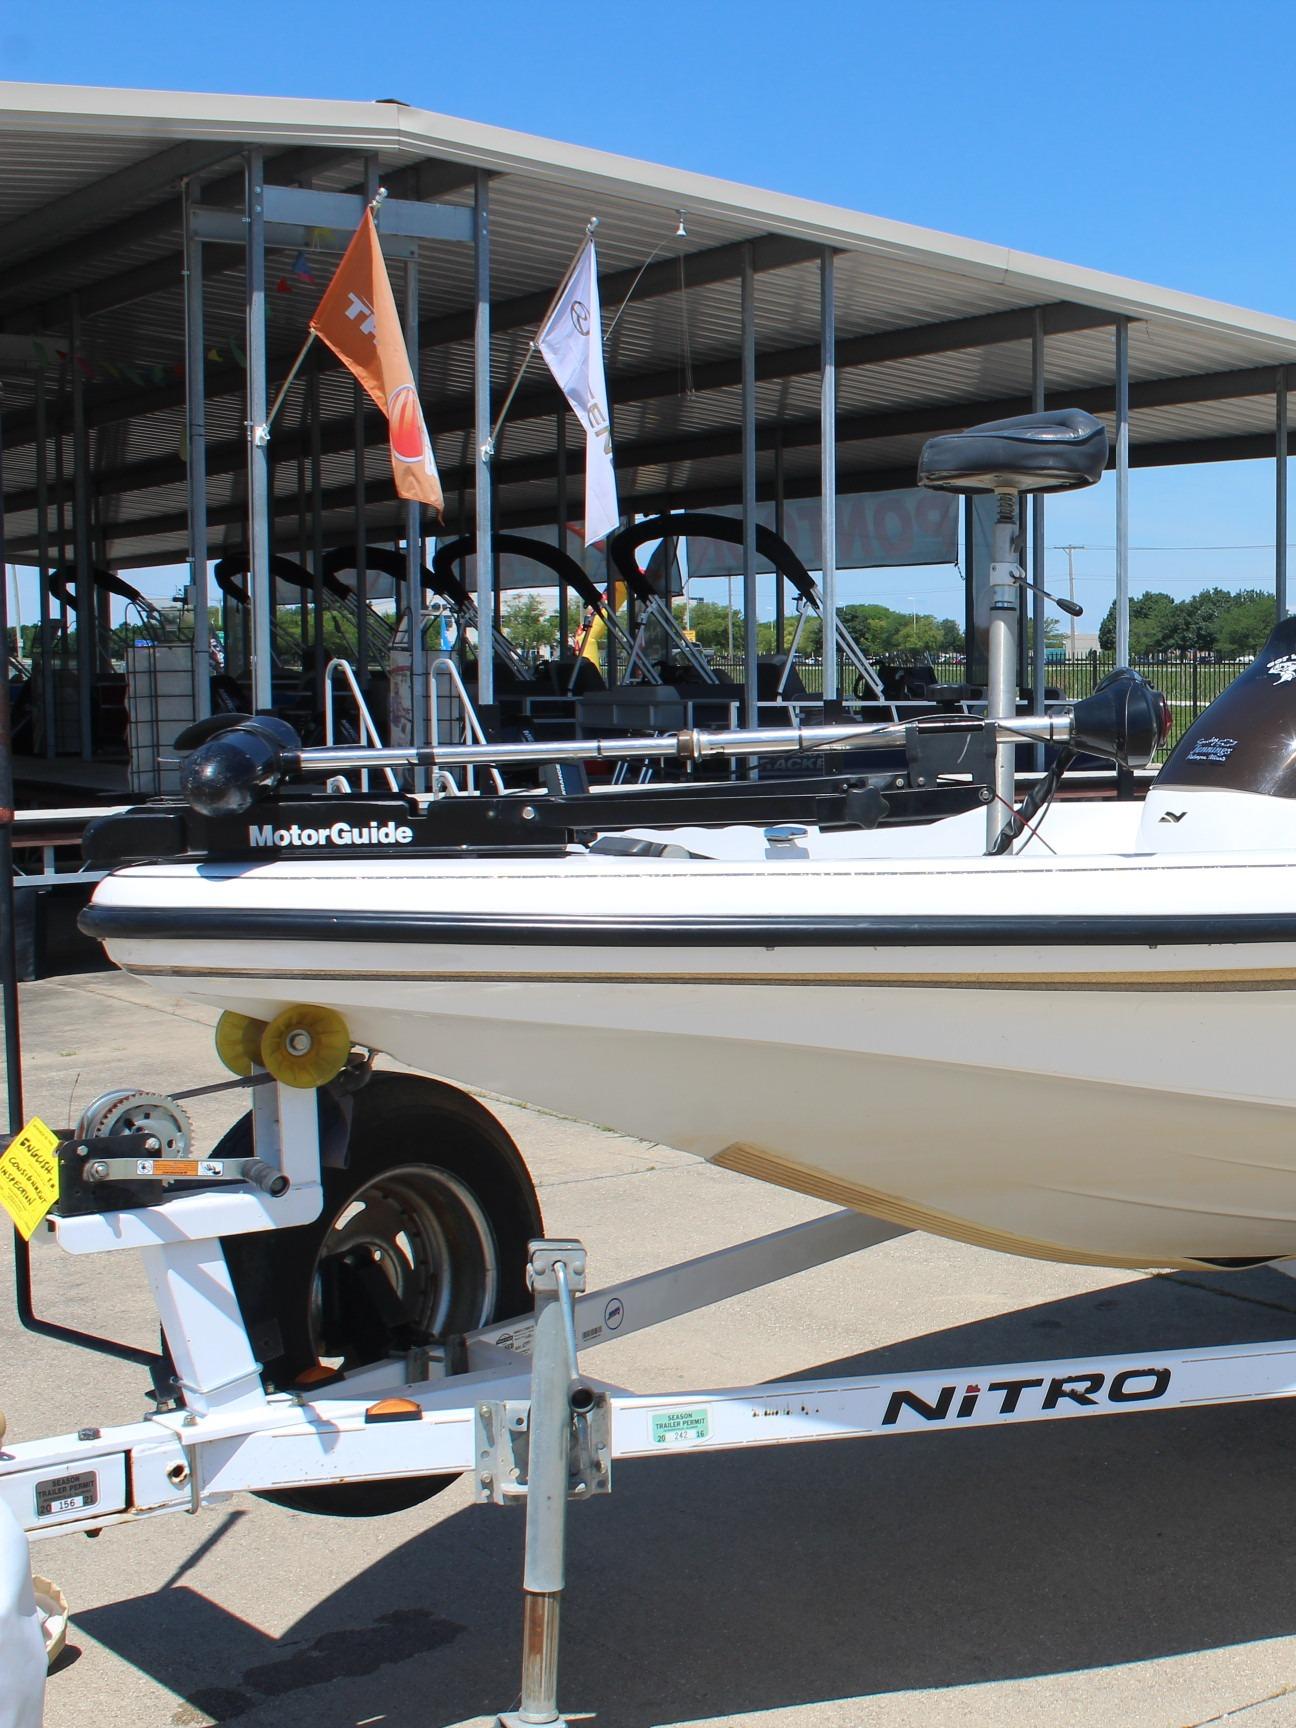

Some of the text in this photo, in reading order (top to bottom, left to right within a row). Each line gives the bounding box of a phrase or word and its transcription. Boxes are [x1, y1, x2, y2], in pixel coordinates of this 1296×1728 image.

[249, 822, 413, 847] MotorGuide
[667, 1412, 693, 1421] SEASON
[656, 1420, 681, 1430] TRAILER
[682, 1418, 705, 1426] PERMIT
[657, 1434, 666, 1442] 20
[52, 1475, 80, 1487] SEASON
[38, 1487, 67, 1499] TRAILER
[69, 1480, 95, 1491] PERMIT
[59, 1498, 76, 1510] 156
